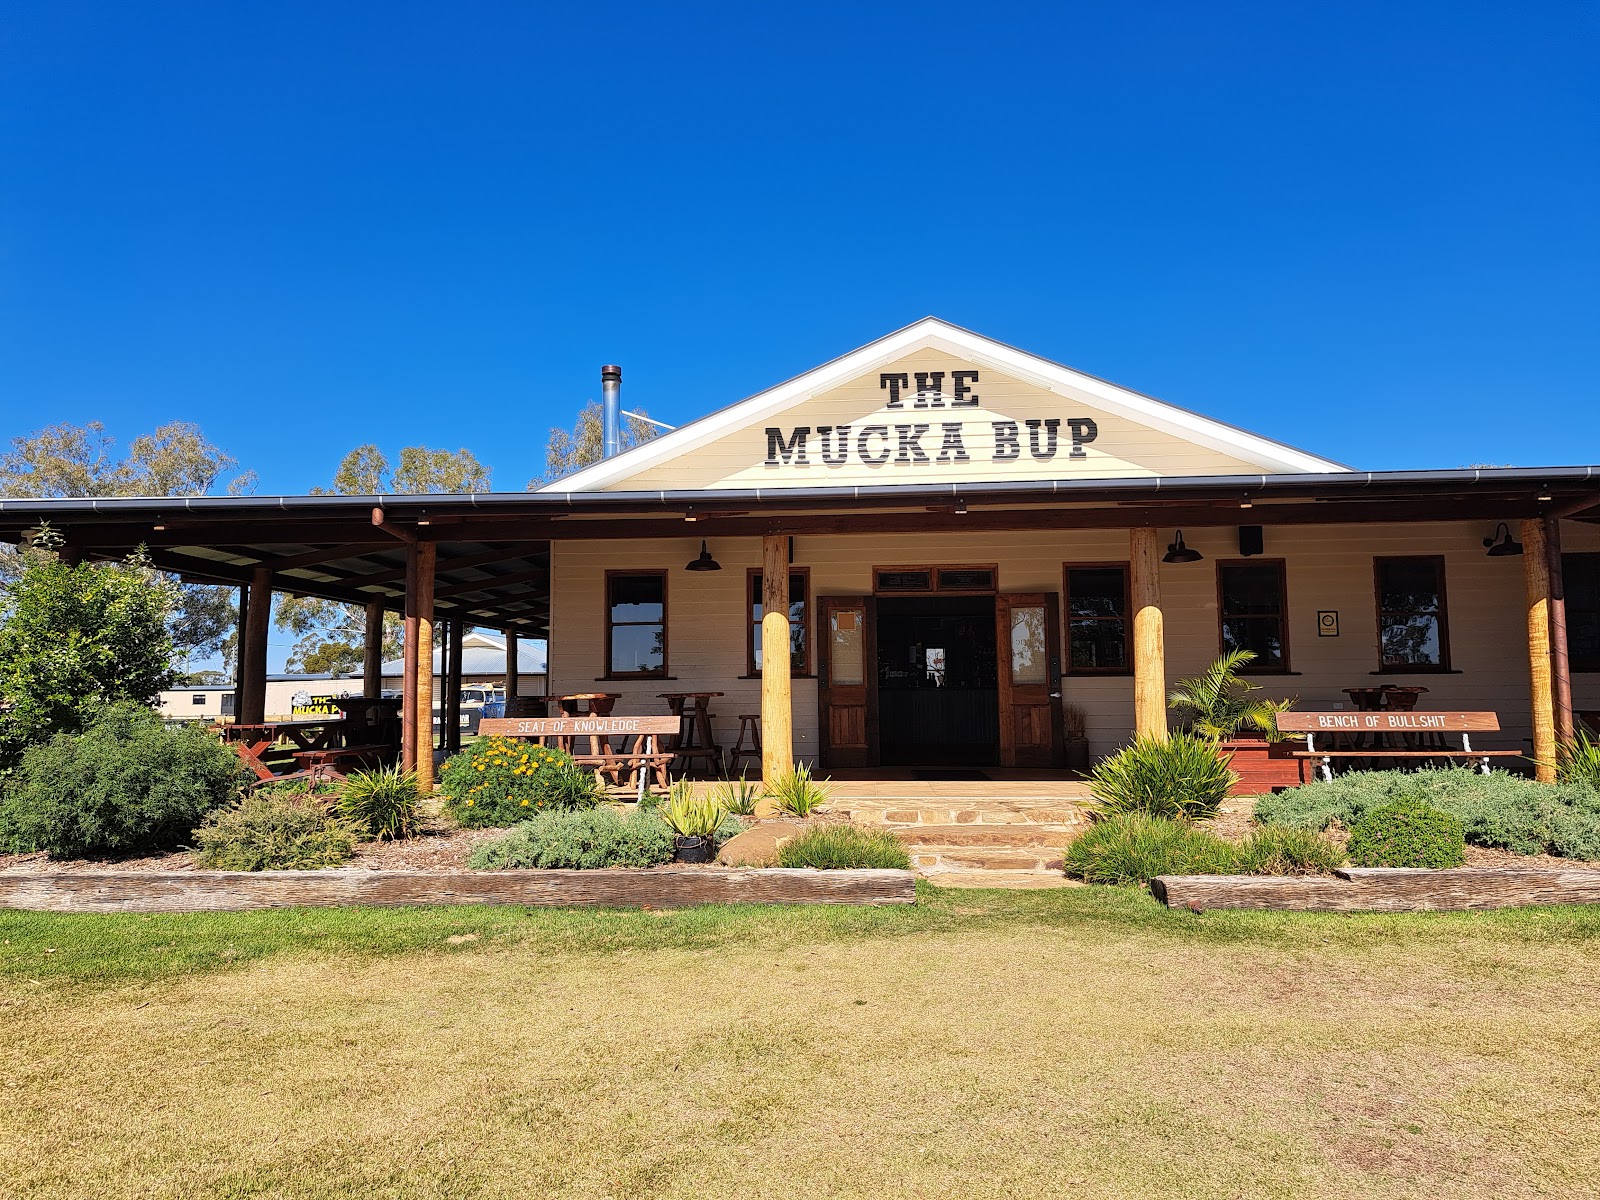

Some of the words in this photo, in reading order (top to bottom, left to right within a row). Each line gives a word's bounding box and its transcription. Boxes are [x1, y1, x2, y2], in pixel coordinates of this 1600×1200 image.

[880, 370, 979, 410] THE
[764, 422, 971, 468] MUCKA
[991, 417, 1099, 464] BUP
[293, 705, 329, 714] MUCKA
[518, 721, 546, 733] SEAT
[553, 721, 567, 732] OF
[574, 720, 640, 732] KNOWLEDGE
[1318, 715, 1359, 728] BENCH
[1365, 715, 1380, 727] OF
[1388, 715, 1446, 728] BULLSHIT
